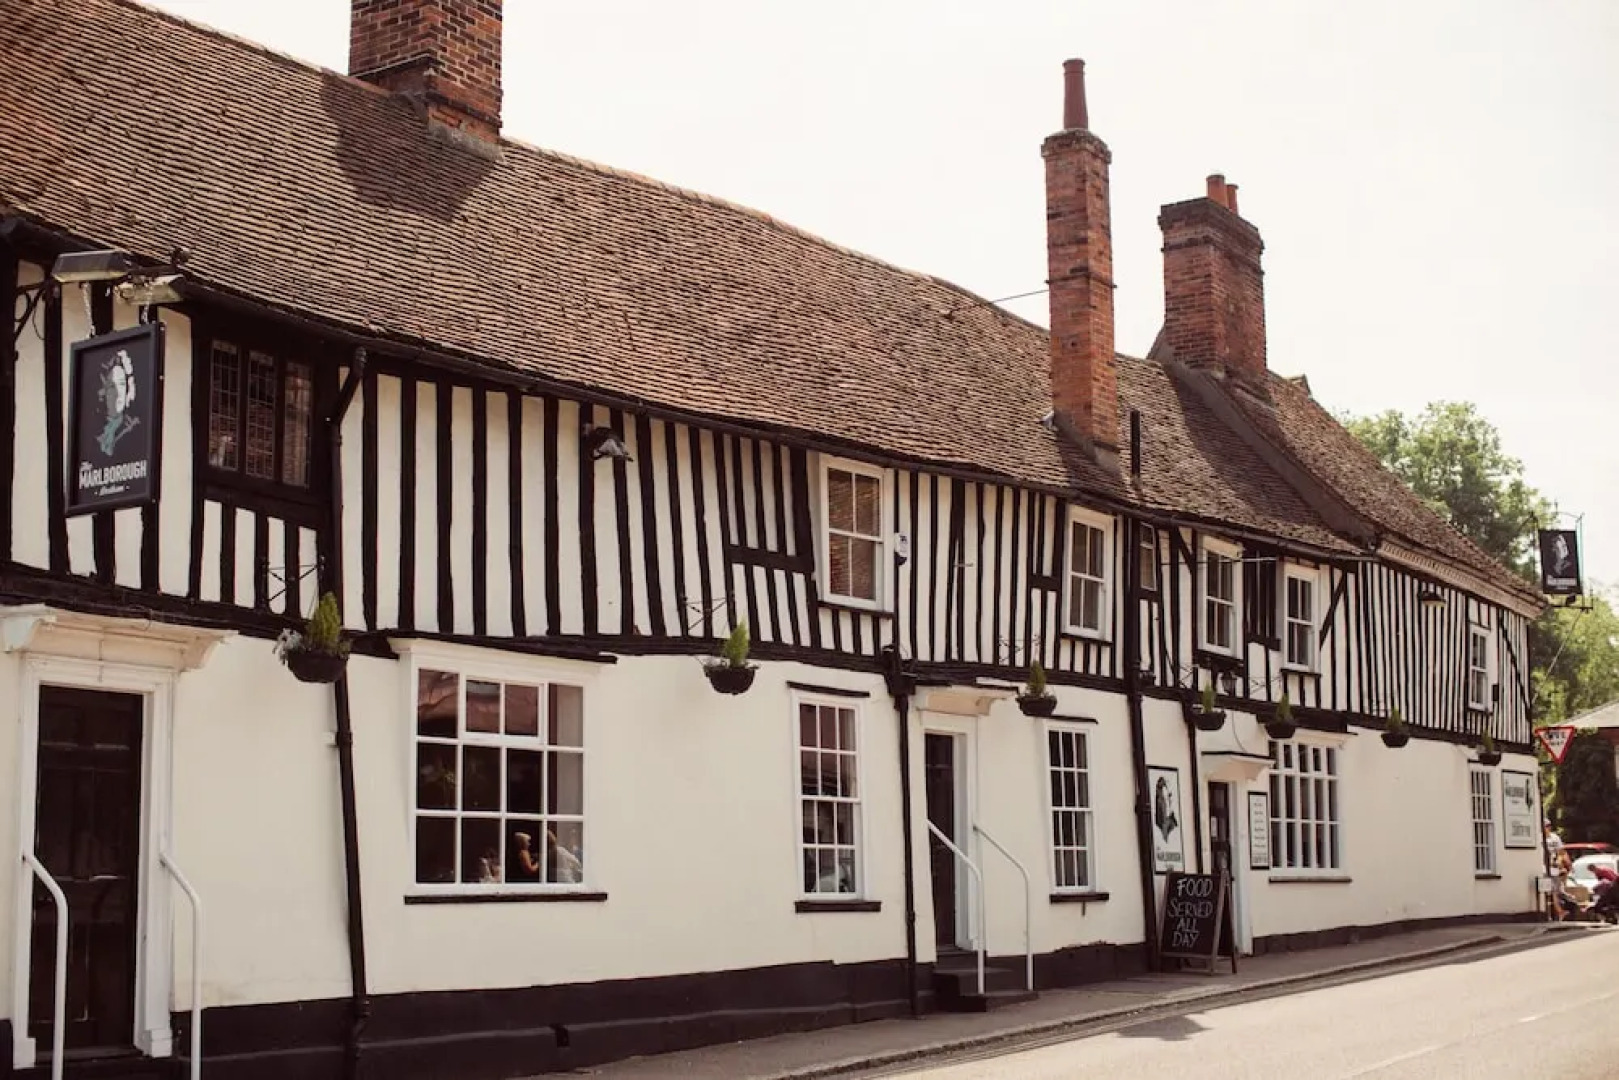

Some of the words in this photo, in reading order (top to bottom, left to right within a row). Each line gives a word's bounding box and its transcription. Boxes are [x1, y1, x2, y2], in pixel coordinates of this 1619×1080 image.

[79, 460, 147, 489] MARLBOROUGH
[1176, 878, 1213, 897] FOOD
[1167, 898, 1213, 918] SERVED
[1176, 918, 1199, 933] ALL
[1172, 931, 1199, 948] DAY
